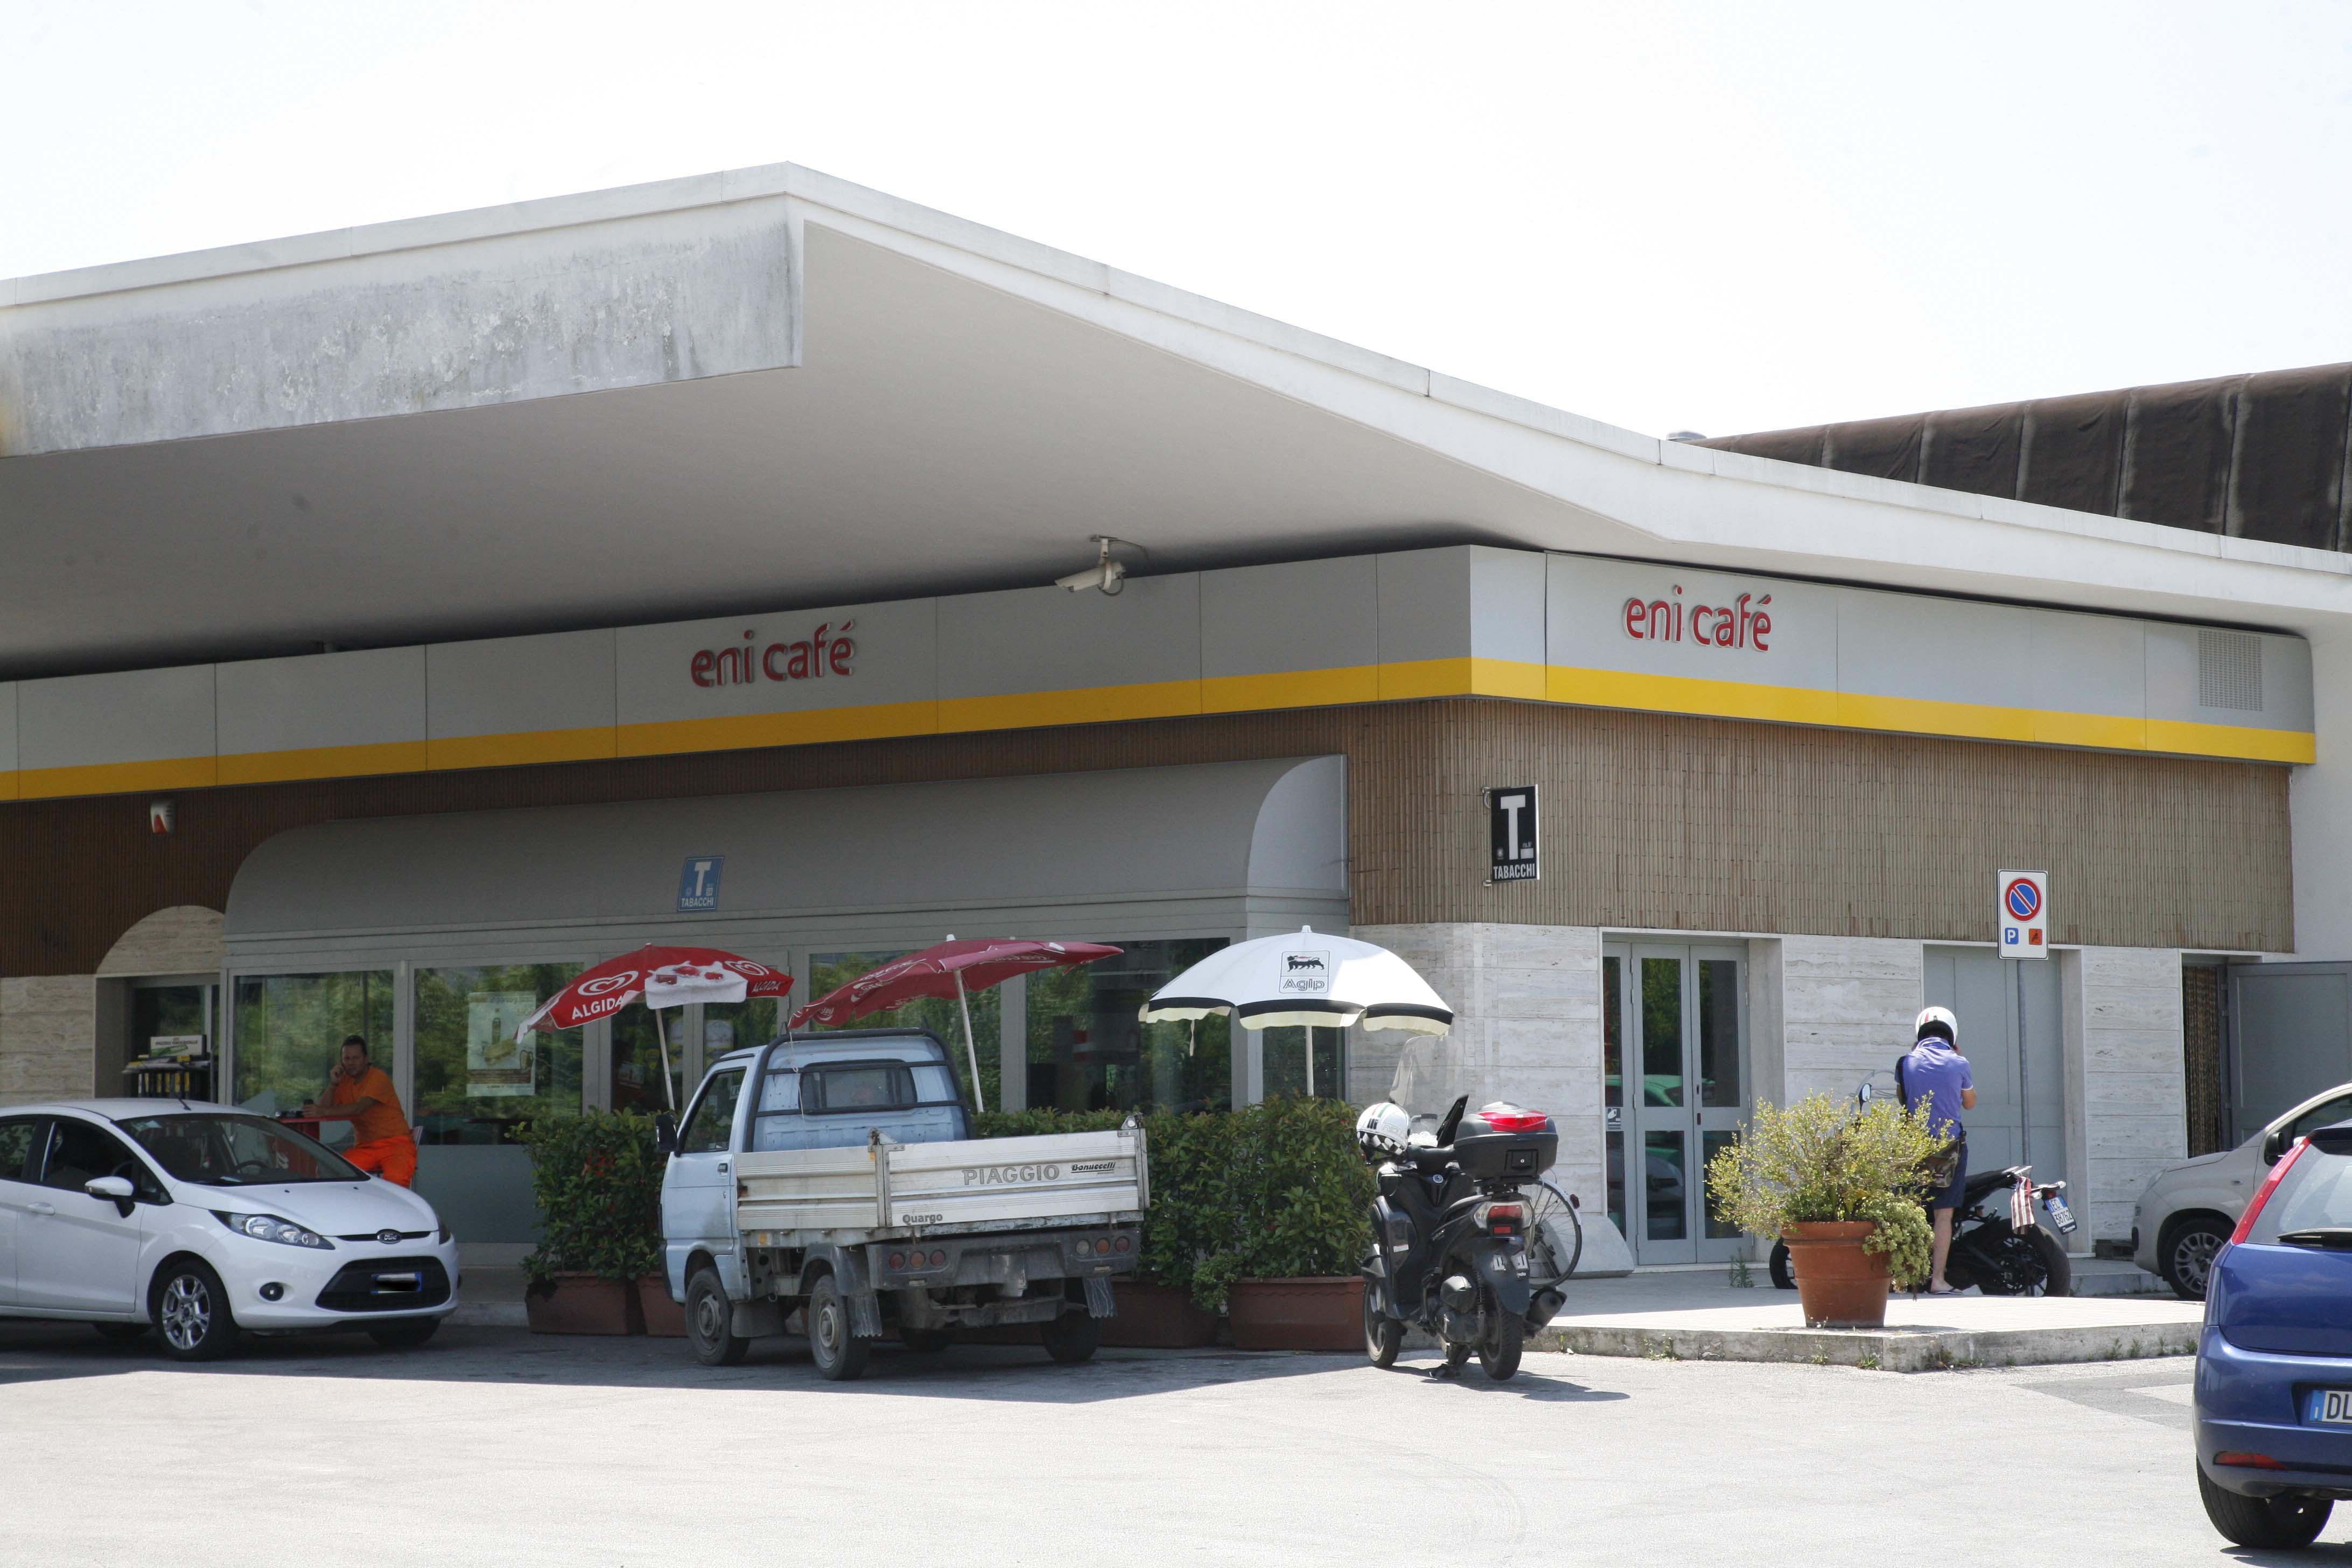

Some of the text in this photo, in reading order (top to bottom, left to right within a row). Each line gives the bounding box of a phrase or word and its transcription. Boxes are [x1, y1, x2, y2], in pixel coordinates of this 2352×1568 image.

[1623, 585, 1772, 652] eni café
[691, 620, 852, 687] eni café
[1501, 795, 1525, 860] T
[695, 862, 712, 896] T
[1493, 864, 1535, 879] TABACCHI
[681, 897, 714, 907] TABACCHI
[2007, 929, 2016, 942] P
[1283, 978, 1325, 991] Agip
[572, 995, 624, 1020] ALGIDA
[962, 1164, 1060, 1185] PIAGGIO
[902, 1214, 943, 1226] Quargo
[2326, 1394, 2352, 1420] DL
